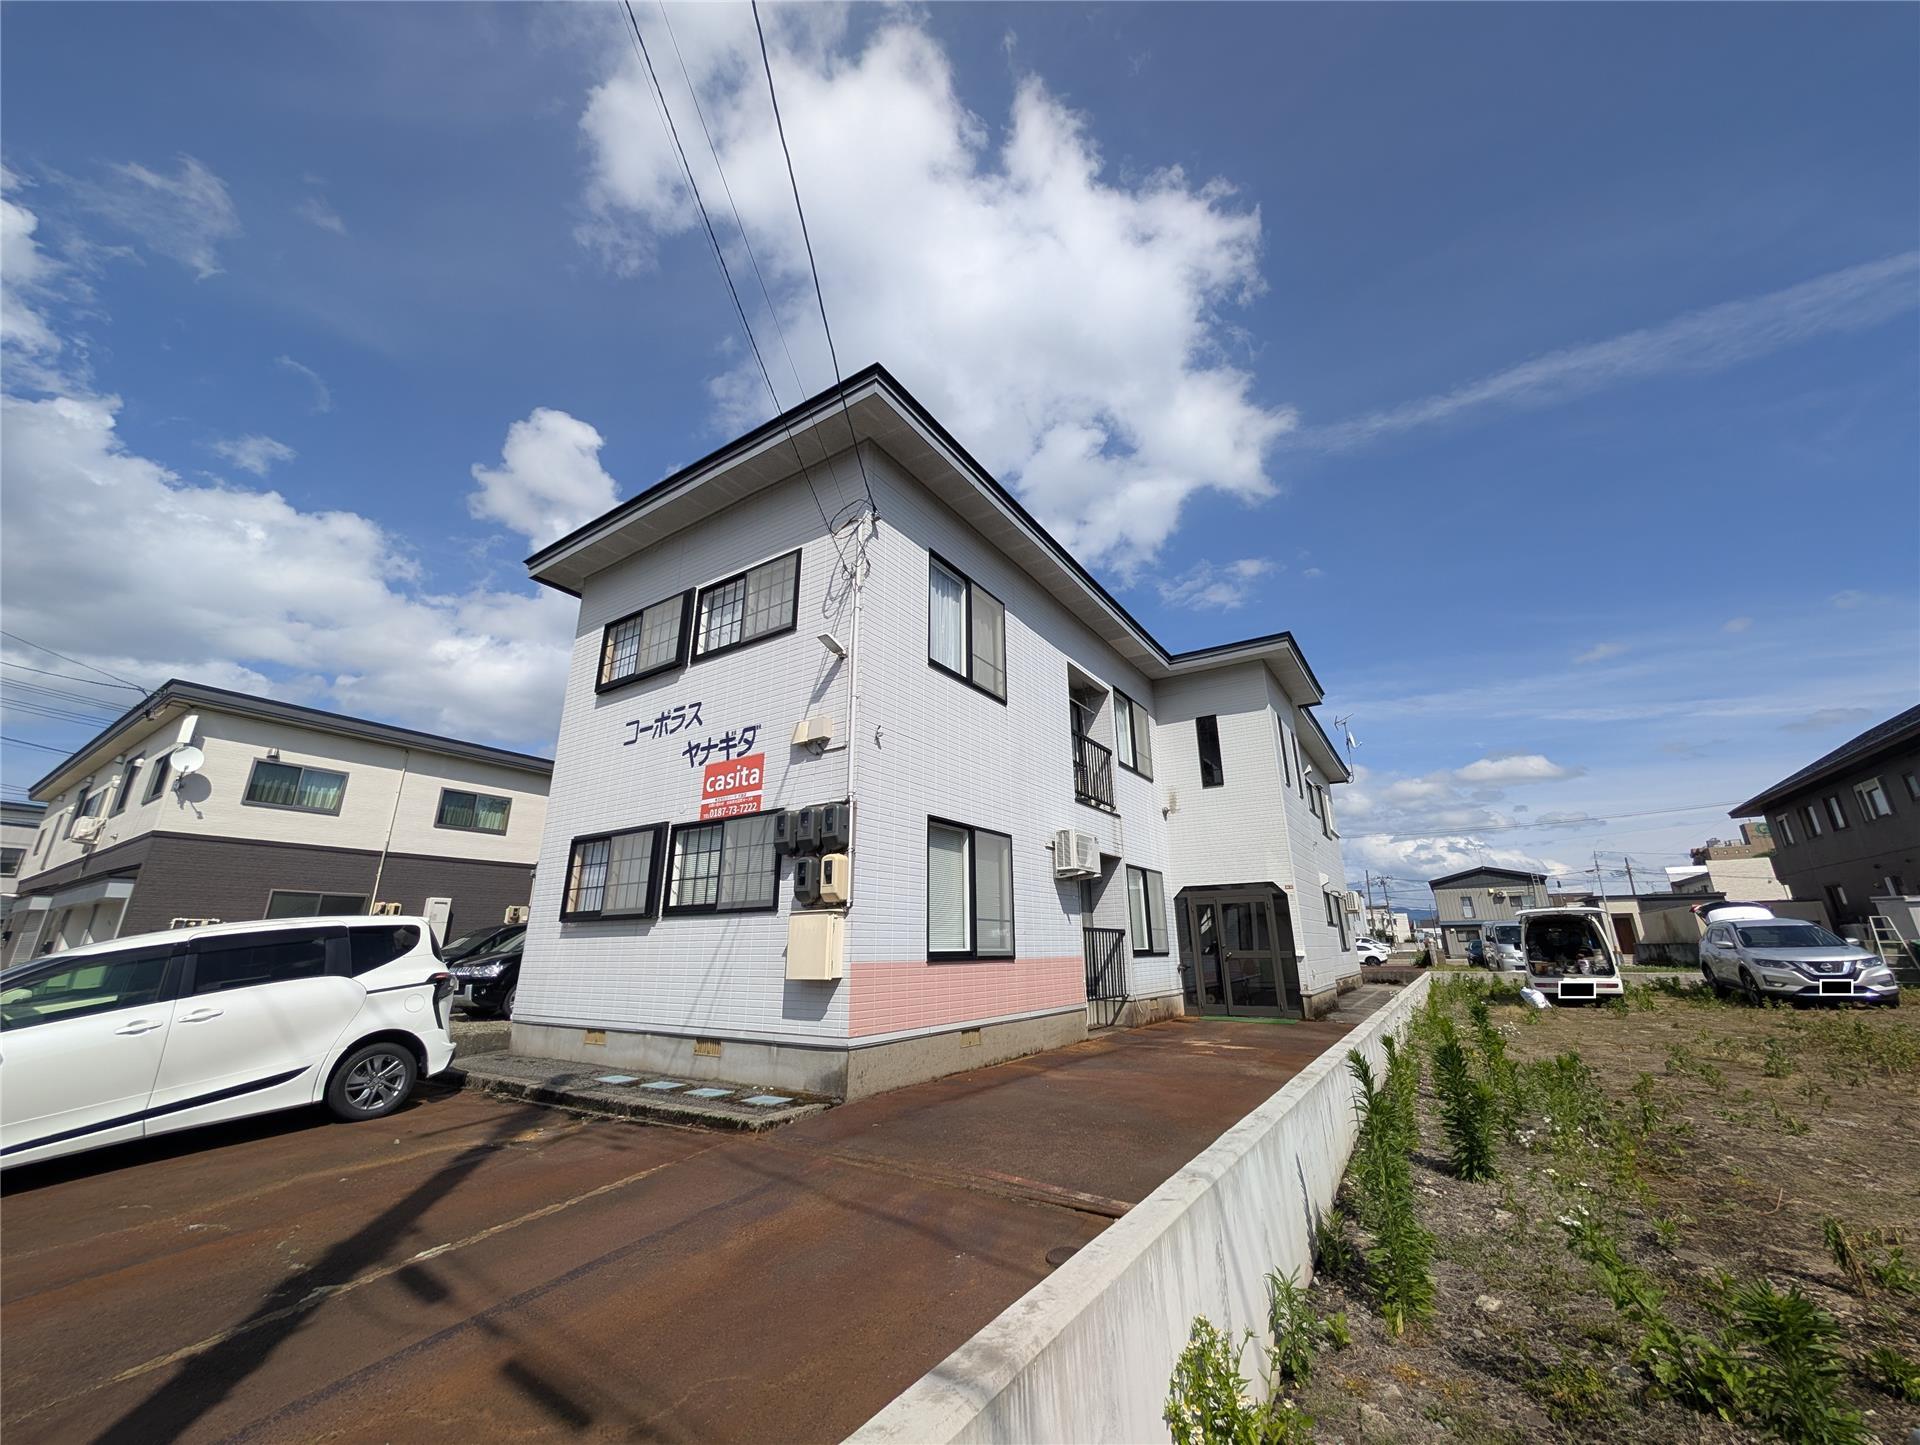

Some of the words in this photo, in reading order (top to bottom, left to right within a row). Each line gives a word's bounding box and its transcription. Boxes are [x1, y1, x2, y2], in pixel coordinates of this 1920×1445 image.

[623, 701, 703, 746] コーポラス
[682, 724, 762, 768] ヤナギダ
[706, 764, 760, 793] casita
[709, 802, 757, 818] 0187-73-7222
